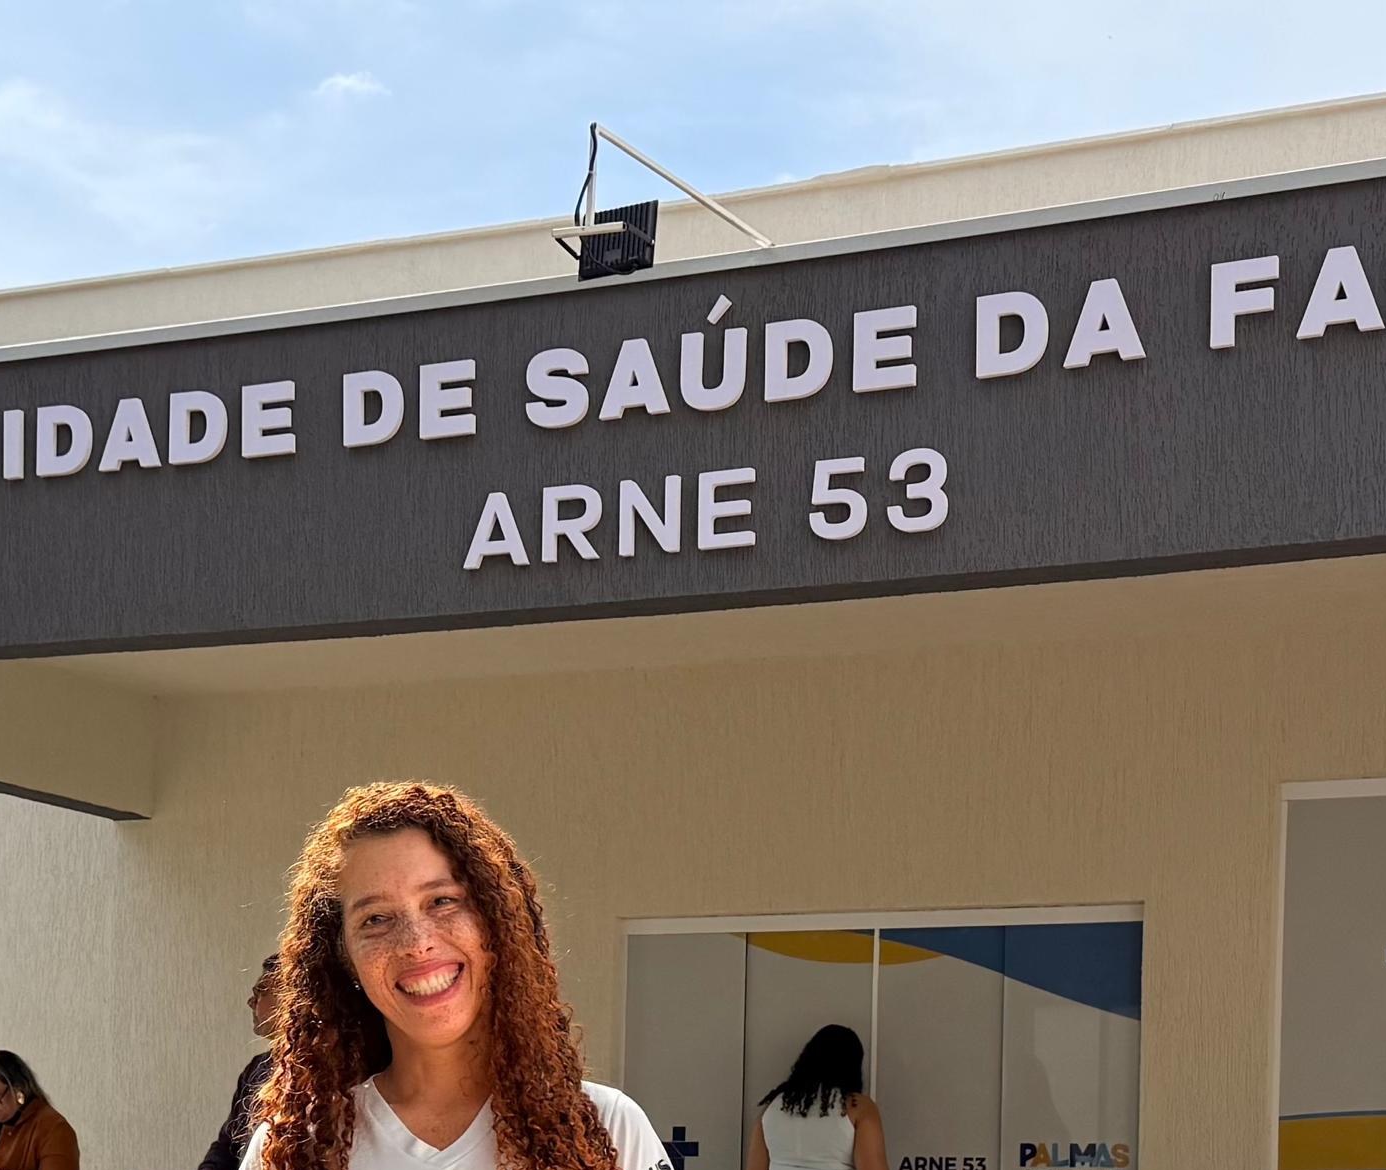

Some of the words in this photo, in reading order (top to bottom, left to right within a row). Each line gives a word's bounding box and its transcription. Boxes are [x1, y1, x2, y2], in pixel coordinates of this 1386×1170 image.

[343, 359, 477, 448] DE
[525, 294, 919, 428] SAÚDE
[975, 278, 1147, 379] DA
[462, 468, 757, 571] ARNE
[808, 447, 950, 541] 53
[1019, 1143, 1130, 1168] PALMAS
